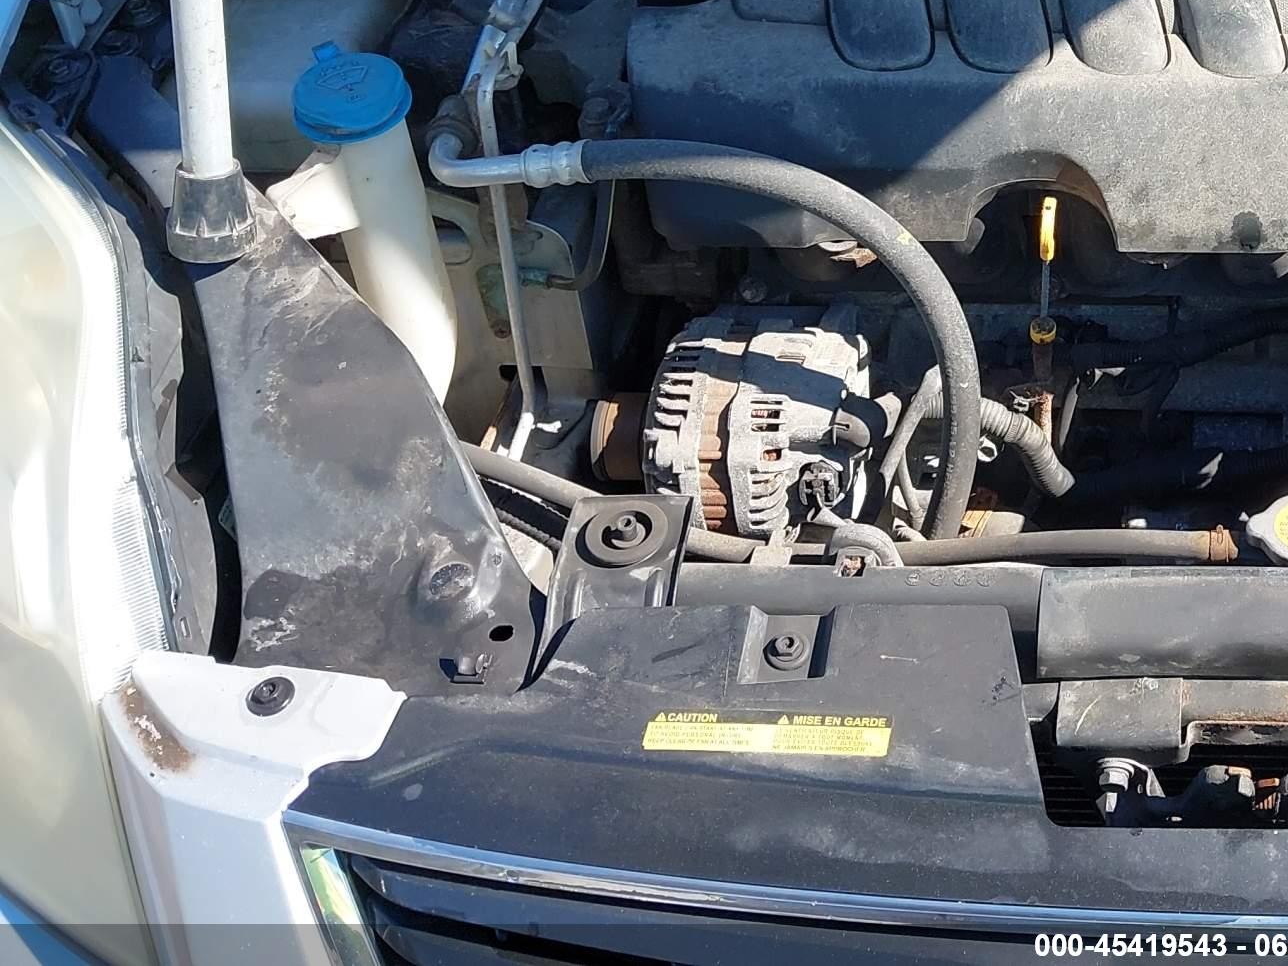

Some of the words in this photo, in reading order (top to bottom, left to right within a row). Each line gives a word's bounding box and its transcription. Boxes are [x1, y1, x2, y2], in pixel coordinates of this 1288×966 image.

[667, 712, 718, 722] CAUTION
[792, 715, 822, 725] MISE
[824, 716, 842, 726] EN
[844, 716, 887, 727] GARDE
